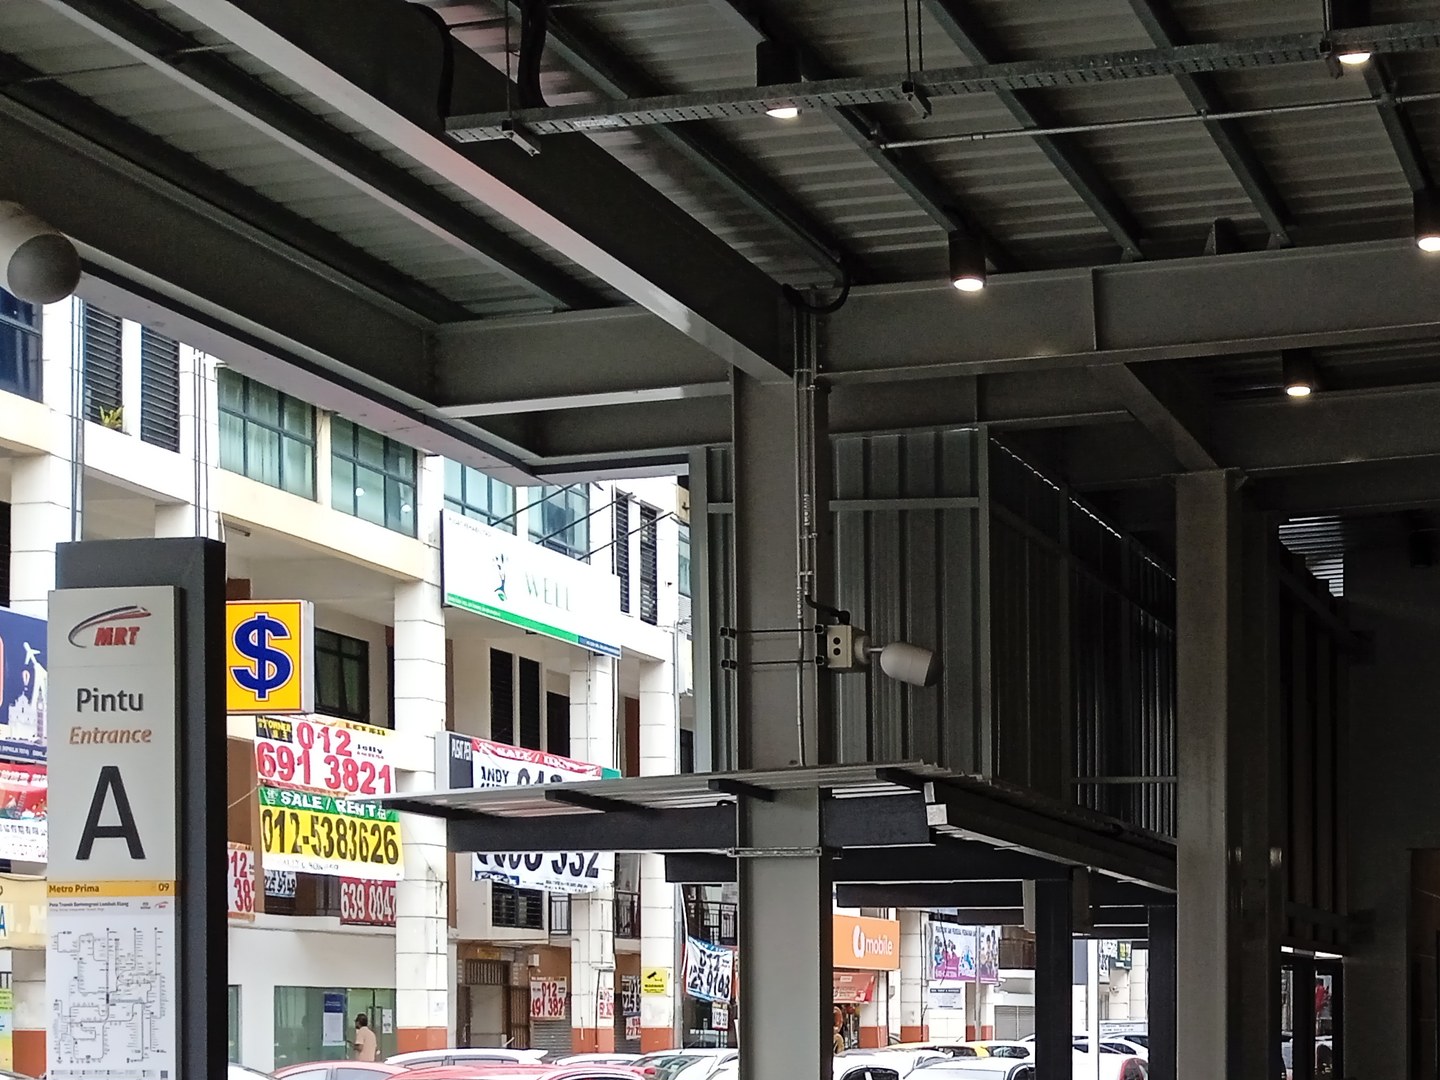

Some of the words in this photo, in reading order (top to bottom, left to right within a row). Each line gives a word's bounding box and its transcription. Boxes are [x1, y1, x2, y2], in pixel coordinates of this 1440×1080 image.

[94, 625, 141, 647] MRT
[76, 687, 144, 713] Pintu
[69, 726, 152, 746] Entrance
[296, 722, 352, 758] 012
[256, 741, 311, 787] 691
[324, 754, 393, 796] 3821
[75, 765, 146, 861] A
[280, 790, 326, 811] SALE
[335, 799, 377, 818] RENT
[262, 808, 400, 866] 012-5383626
[48, 884, 74, 894] Metro
[74, 883, 100, 893] Prima
[158, 883, 170, 892] 09
[340, 883, 366, 920] 639
[865, 935, 893, 957] mobile
[541, 982, 557, 998] 012
